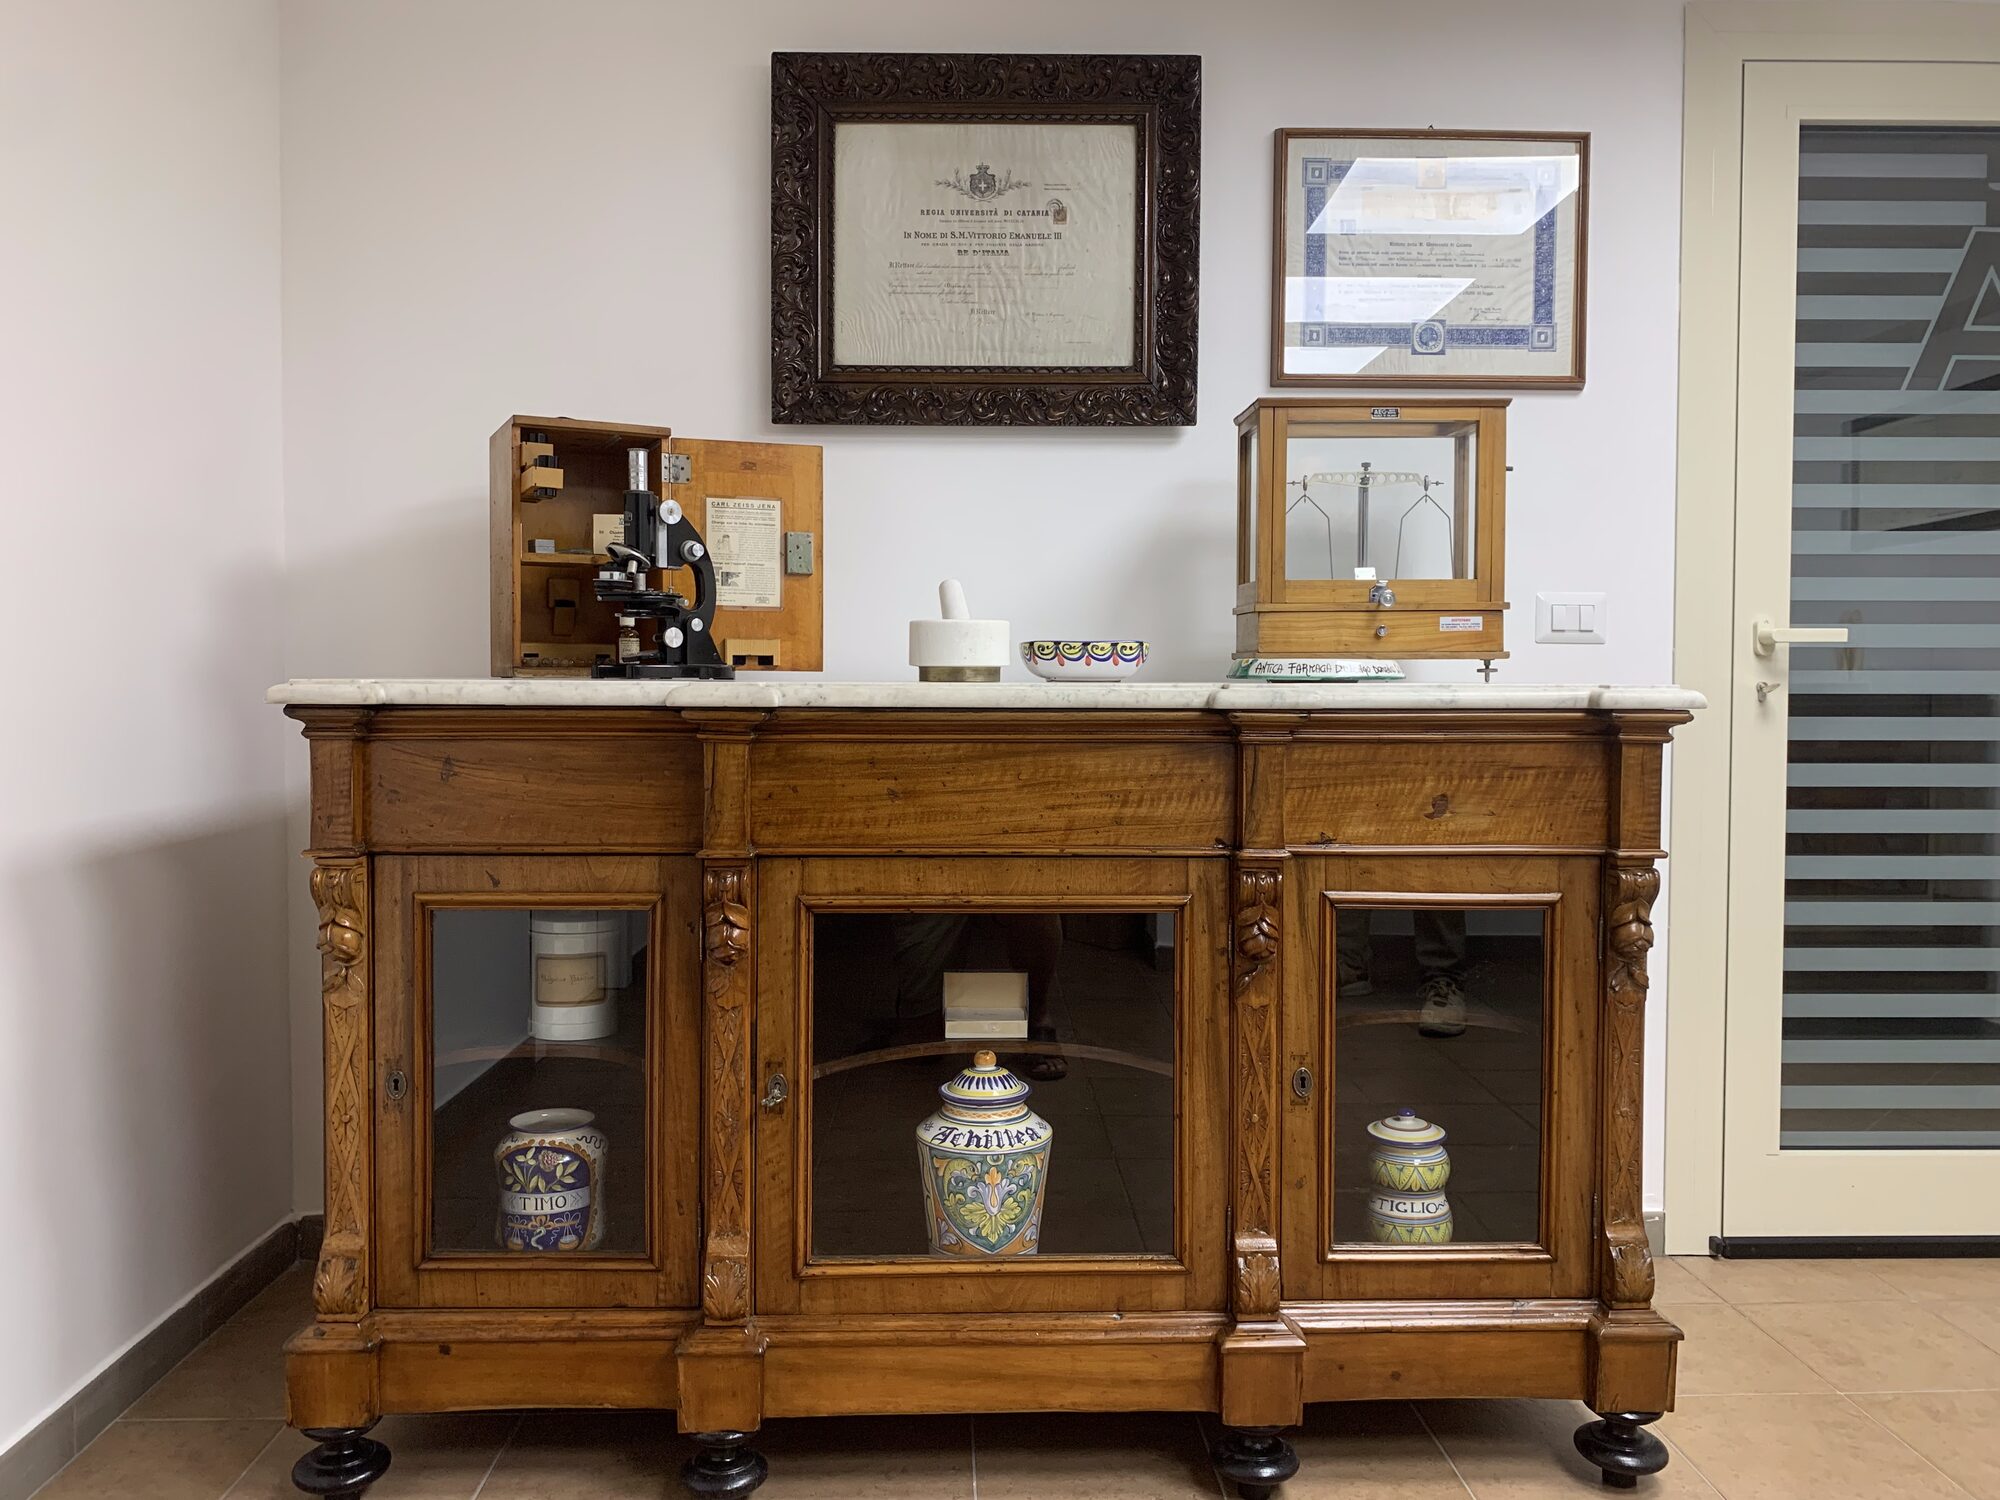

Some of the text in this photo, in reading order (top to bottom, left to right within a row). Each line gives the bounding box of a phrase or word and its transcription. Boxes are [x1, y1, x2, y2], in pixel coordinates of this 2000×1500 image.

[1016, 209, 1050, 217] CATANIA
[1009, 231, 1053, 240] EMANUELE
[1053, 232, 1063, 240] III
[1255, 662, 1284, 674] ANTICA
[930, 1126, 1042, 1149] Achillea
[520, 1195, 567, 1211] TIMO
[1377, 1198, 1438, 1214] TIGLIO
